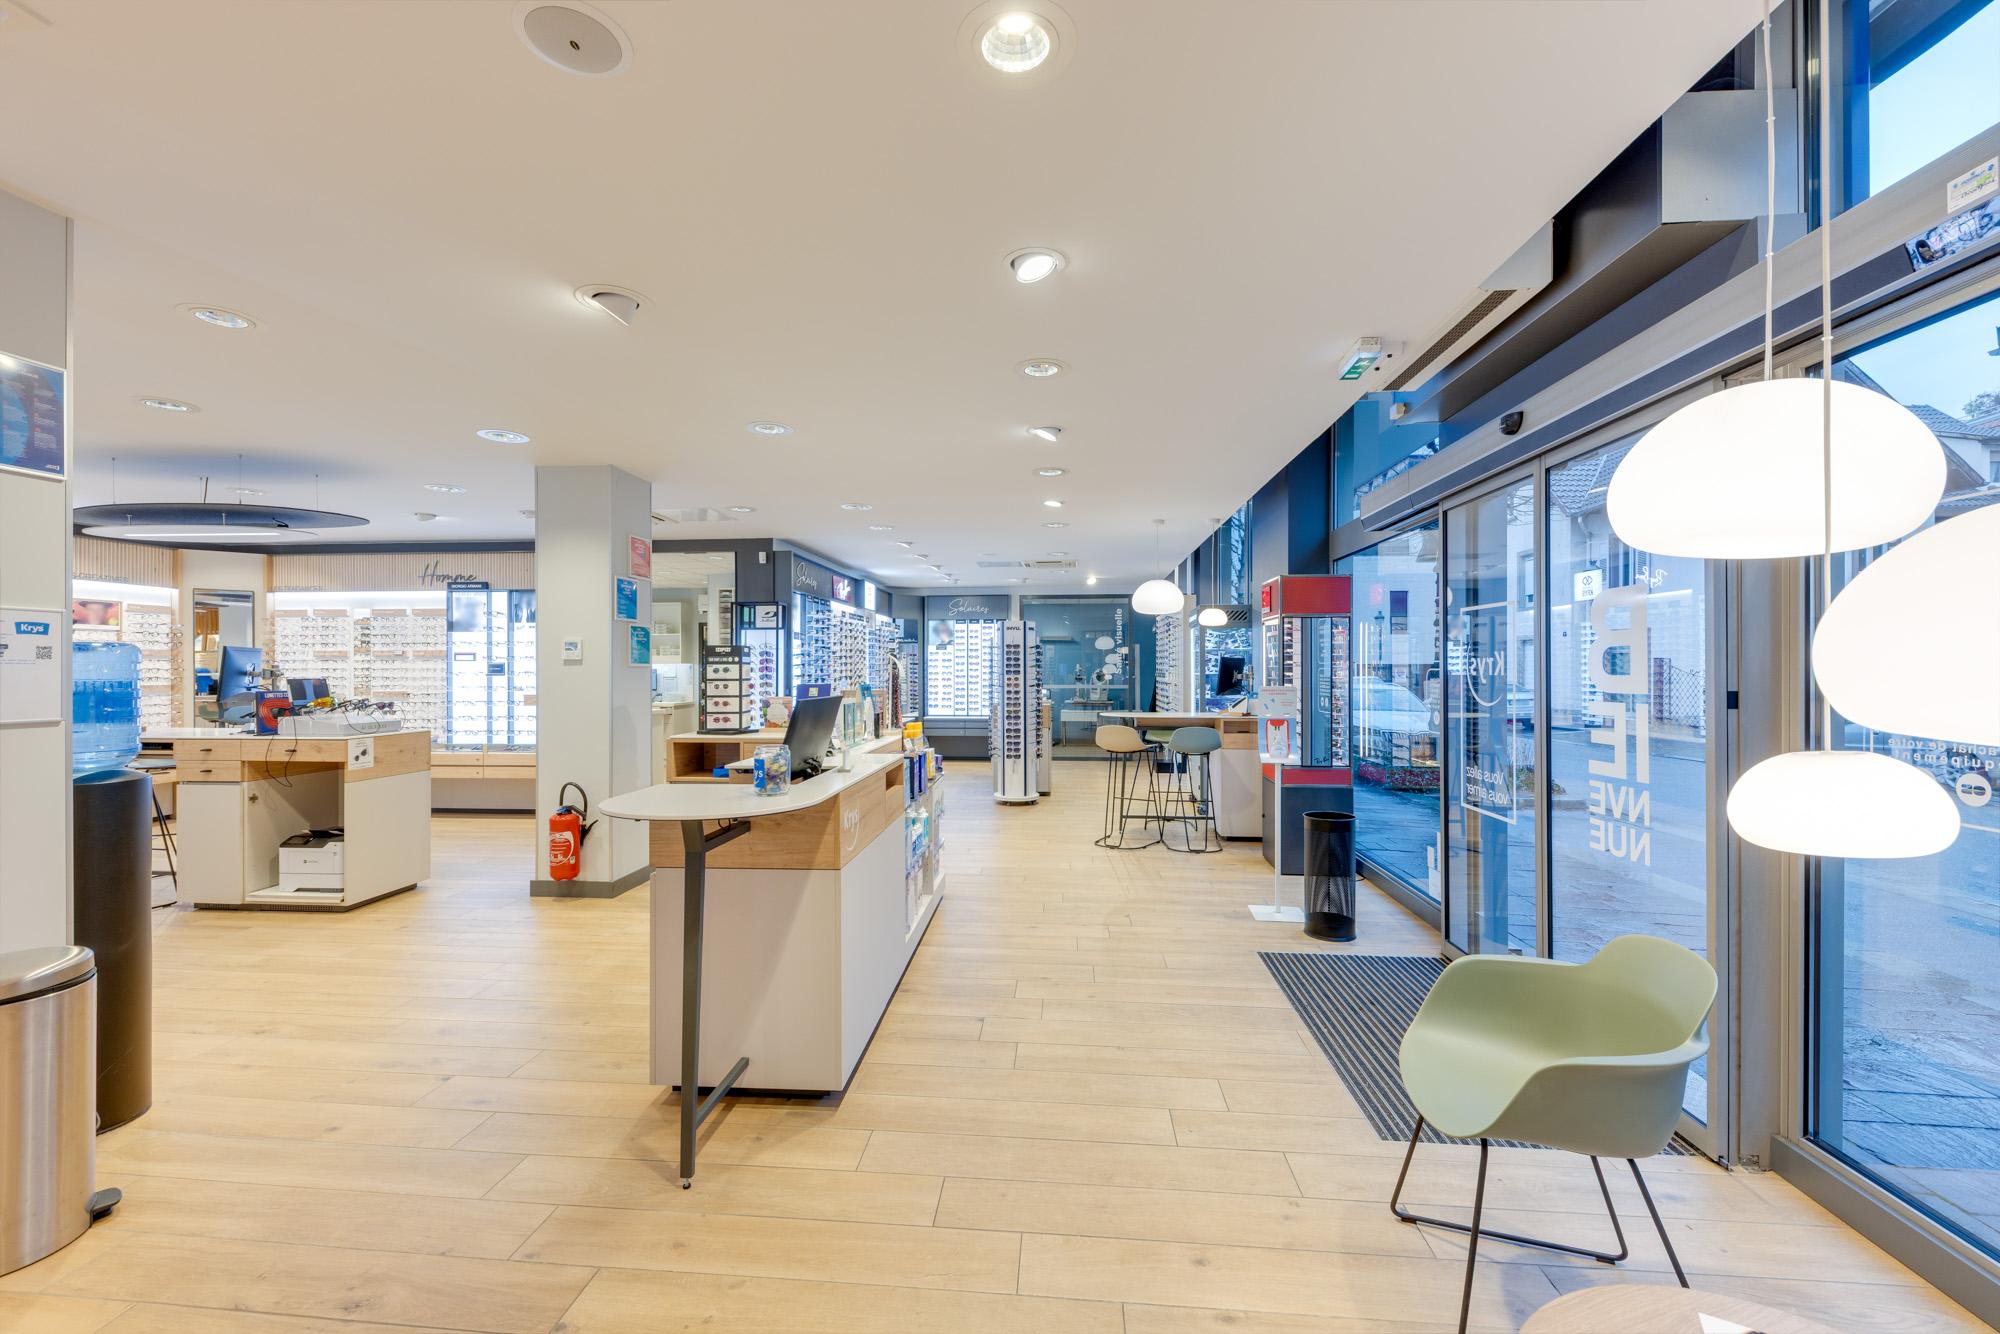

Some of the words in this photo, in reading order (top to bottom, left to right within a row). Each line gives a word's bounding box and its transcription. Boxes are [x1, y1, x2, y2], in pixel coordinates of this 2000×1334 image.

[418, 560, 477, 587] Homme
[20, 623, 45, 633] Krys
[1114, 608, 1123, 645] visuelle
